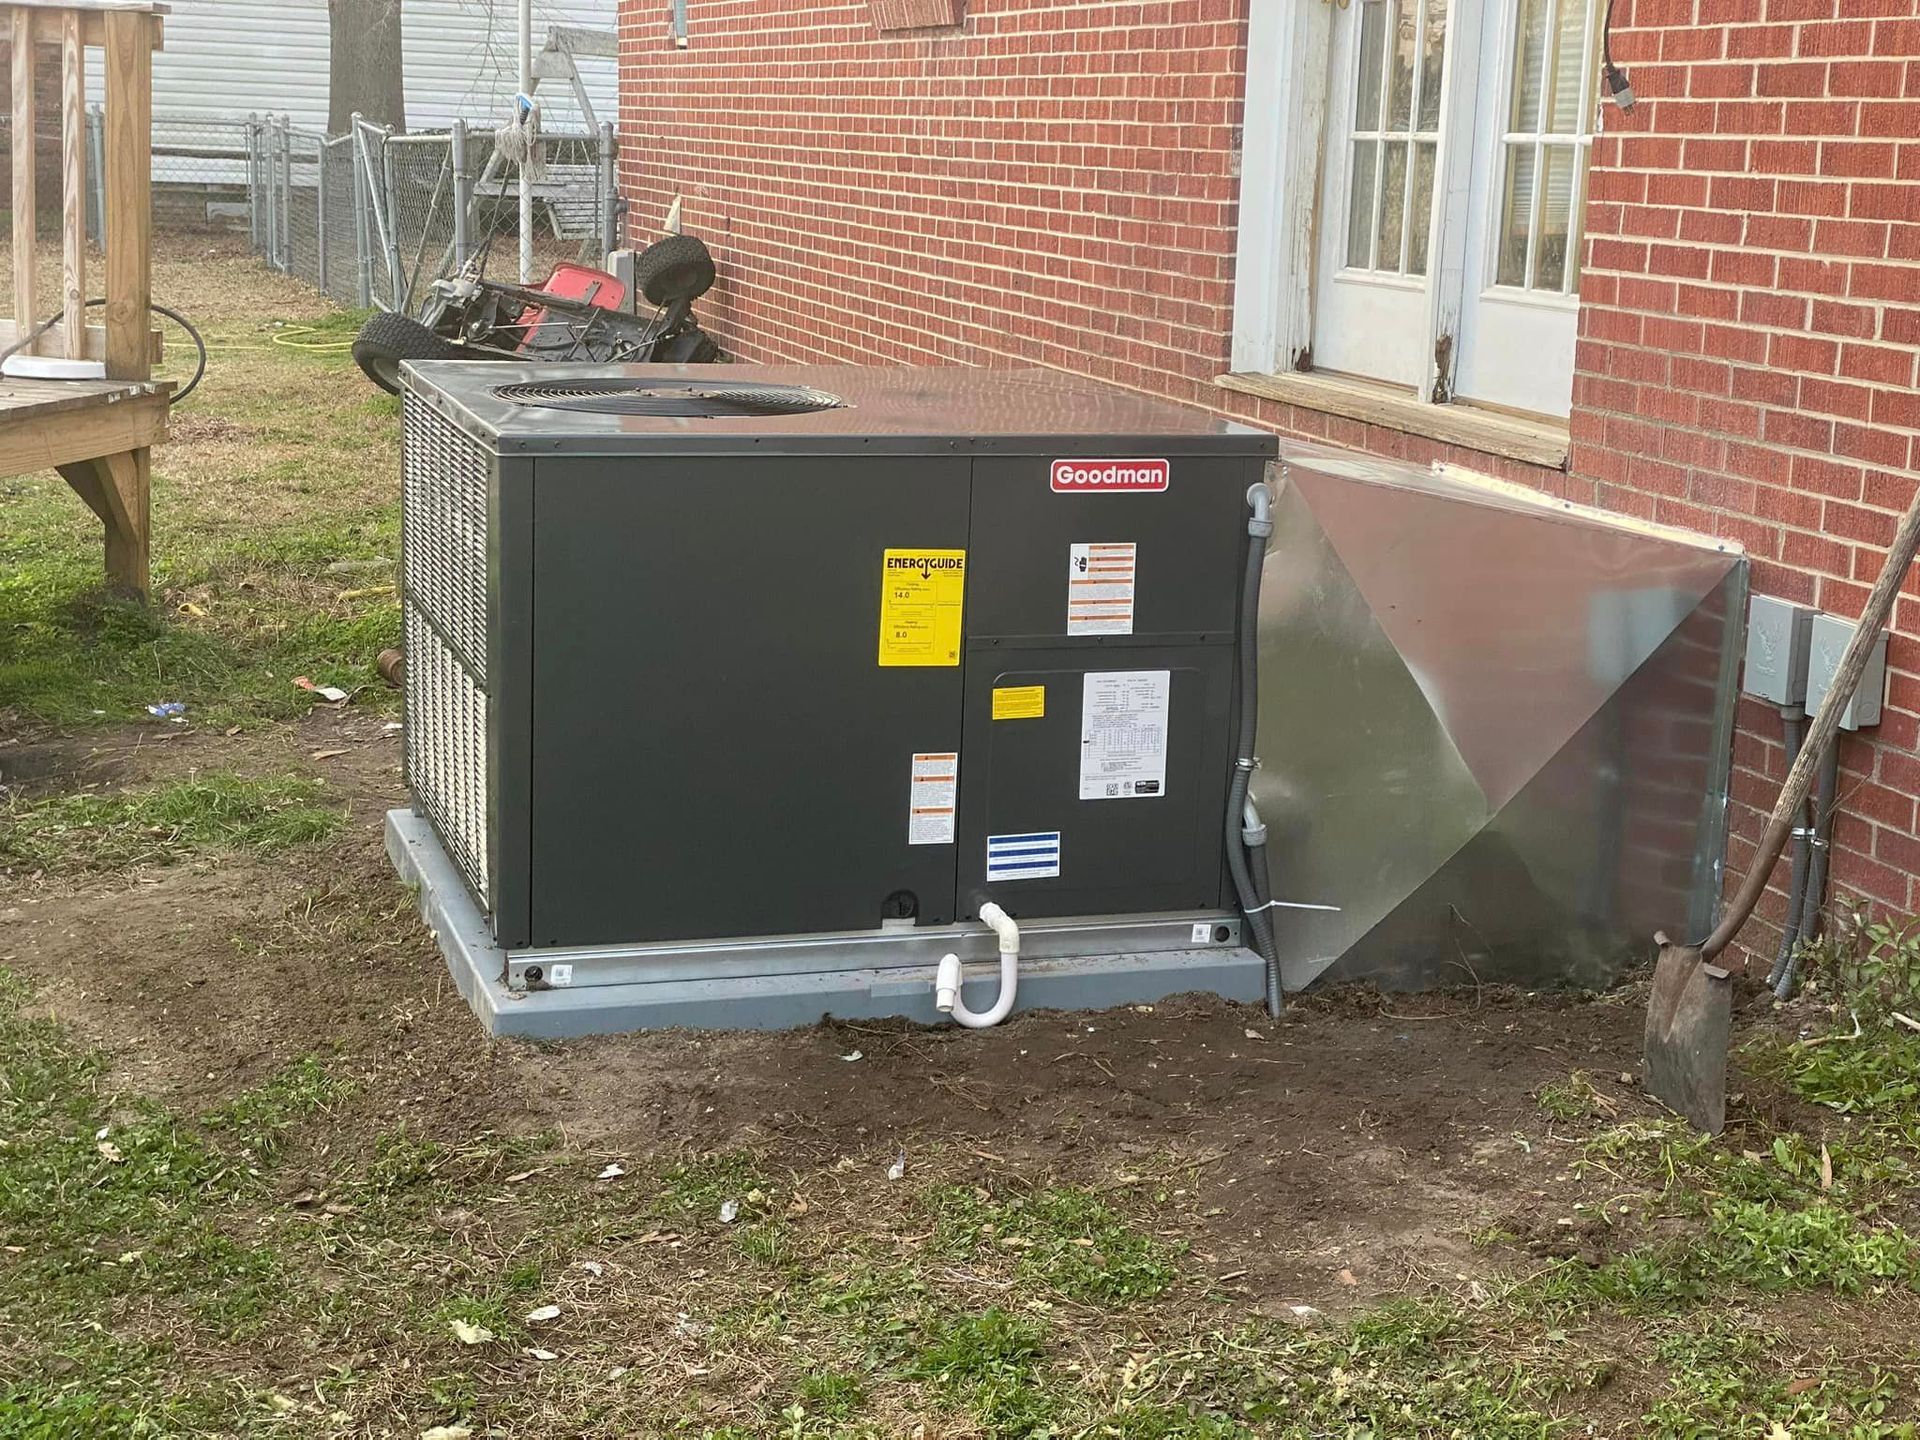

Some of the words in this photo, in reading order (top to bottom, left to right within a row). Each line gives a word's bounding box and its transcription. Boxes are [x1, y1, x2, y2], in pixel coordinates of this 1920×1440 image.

[1056, 465, 1163, 484] Goodman
[887, 557, 964, 569] ENERGYGUIDE
[894, 591, 910, 599] 14.0
